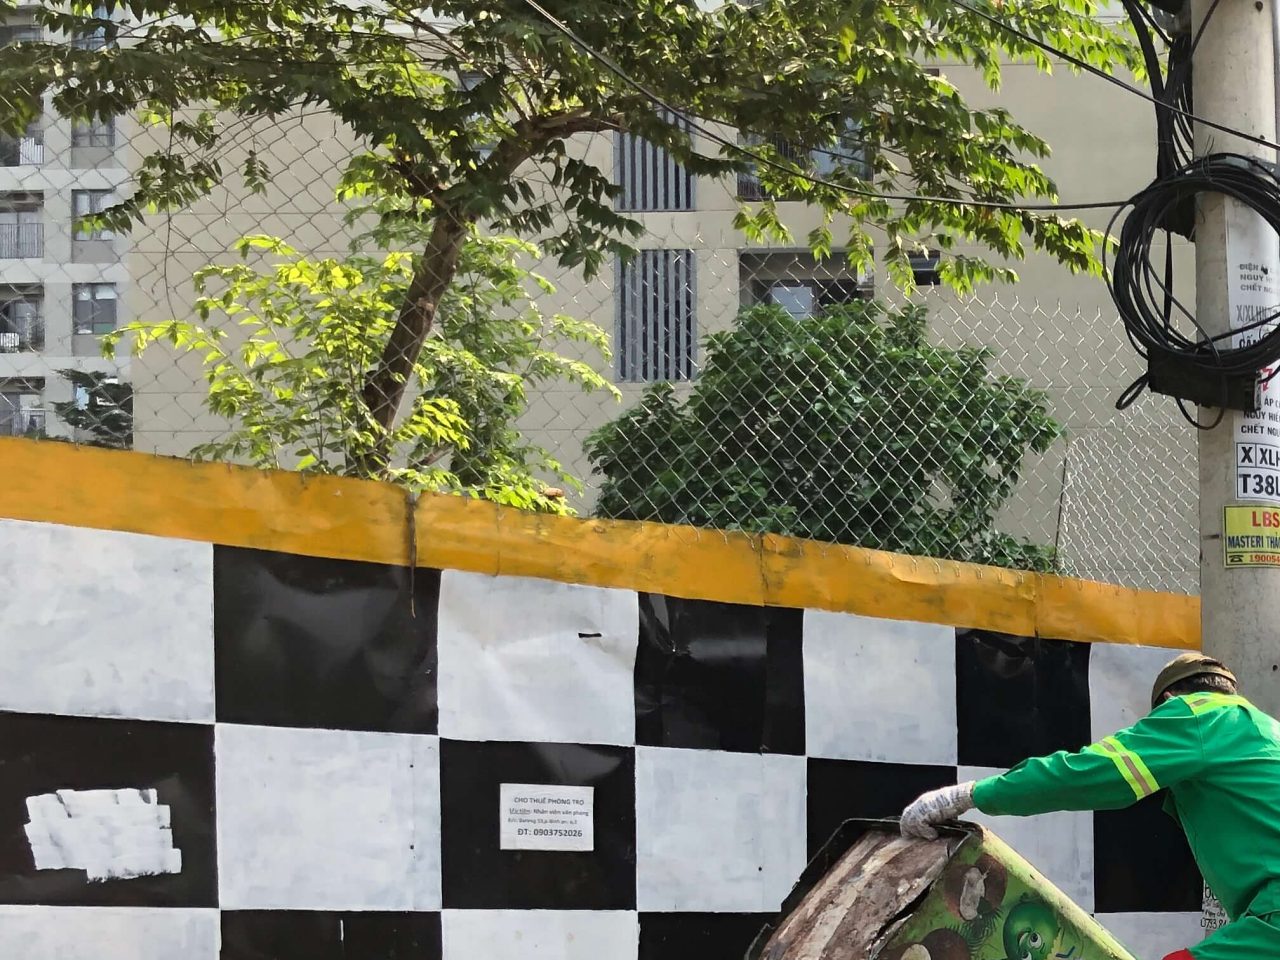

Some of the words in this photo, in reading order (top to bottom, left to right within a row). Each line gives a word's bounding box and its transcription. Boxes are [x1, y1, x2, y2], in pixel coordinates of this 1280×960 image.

[1240, 446, 1253, 464] X
[1252, 511, 1280, 528] LBS
[1228, 535, 1264, 549] MASTERI
